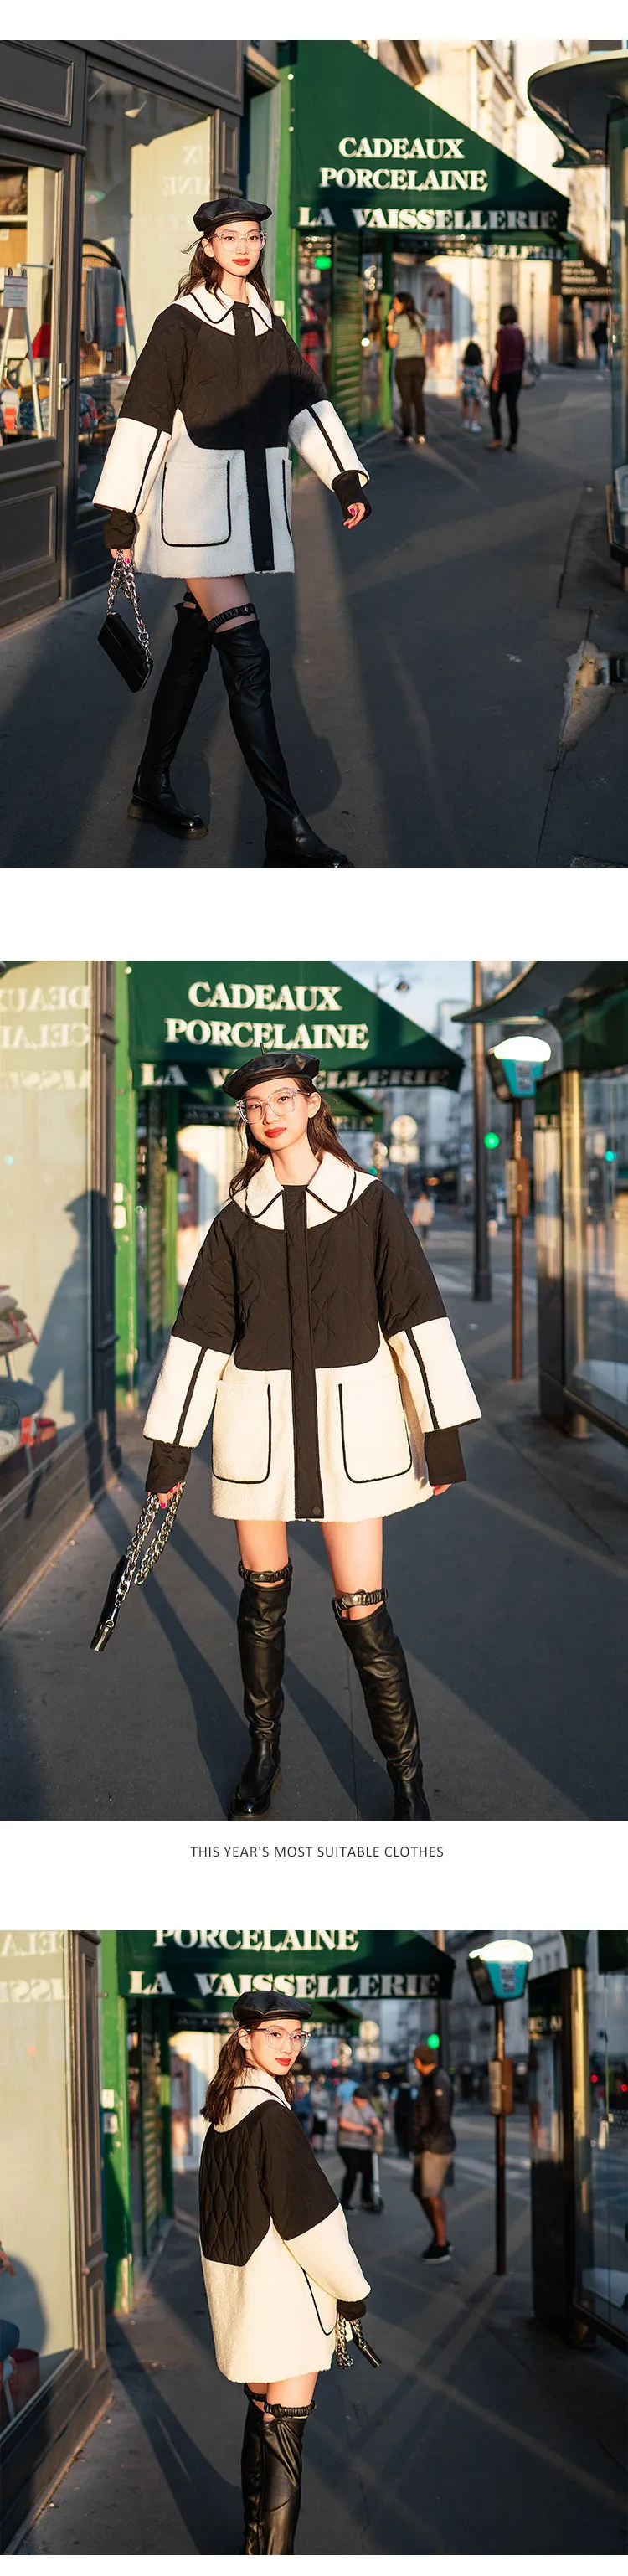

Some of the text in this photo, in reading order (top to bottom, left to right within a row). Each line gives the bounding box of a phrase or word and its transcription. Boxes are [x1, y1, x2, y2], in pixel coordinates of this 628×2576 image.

[338, 137, 466, 160] CADEAUX
[318, 167, 489, 192] PORCELAINE
[298, 207, 559, 230] LA VAISSELLERIE
[188, 981, 342, 1012] CADEAUX
[165, 1018, 370, 1051] PORCELAINE
[141, 1063, 450, 1090] LA VELLERIE
[153, 1930, 360, 1952] PORCELAINE
[129, 1971, 440, 2000] LA VAISSELLERIE
